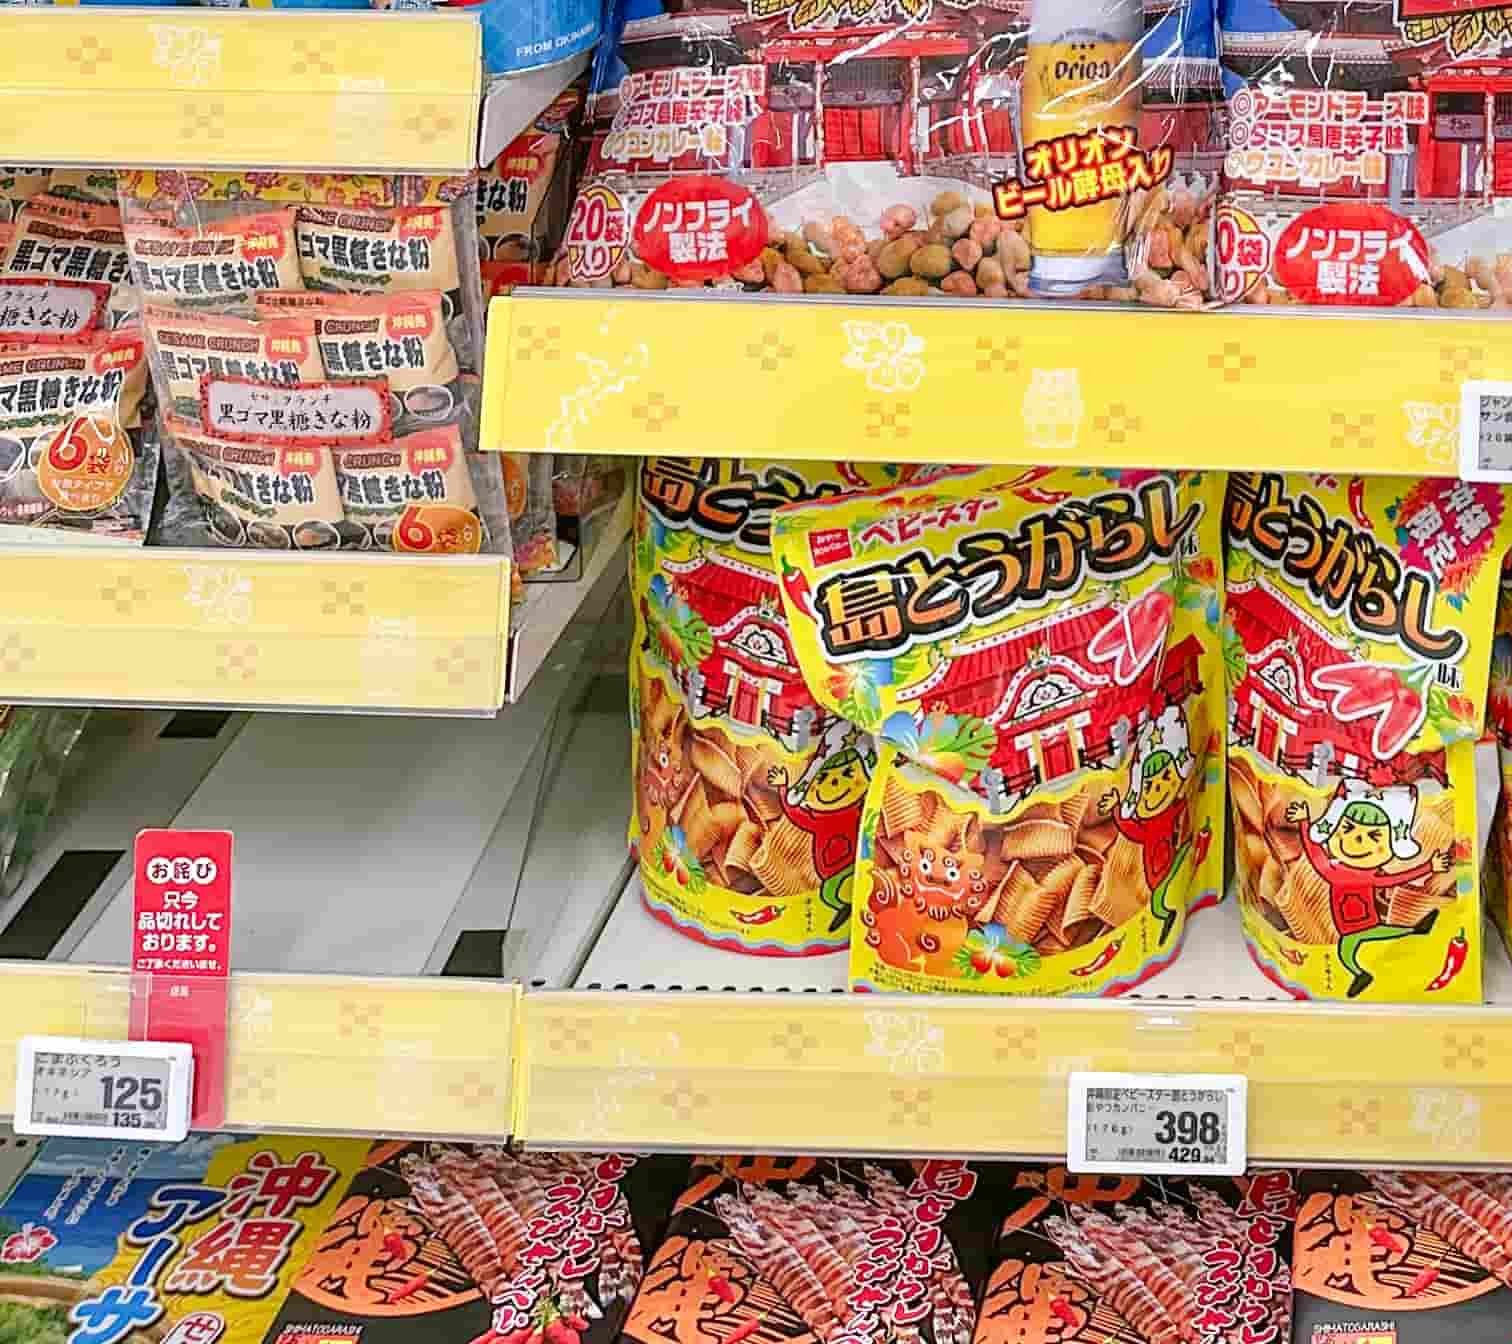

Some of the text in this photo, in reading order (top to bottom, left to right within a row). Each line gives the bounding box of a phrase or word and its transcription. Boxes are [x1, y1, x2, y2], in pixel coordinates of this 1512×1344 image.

[1025, 126, 1137, 186] オリオン
[643, 197, 753, 233] ノンフライ
[1284, 224, 1416, 262] ノンフライ
[216, 402, 374, 433] 黒ゴマ黒糖きな粉
[814, 475, 1203, 652] 島とうがらし
[147, 856, 217, 885] お詫び
[163, 890, 199, 909] 只今
[138, 911, 223, 931] 品切れして
[141, 932, 217, 953] おります。
[99, 1075, 163, 1111] 125
[1154, 1109, 1221, 1146] 398
[166, 1151, 338, 1297] 沖縄
